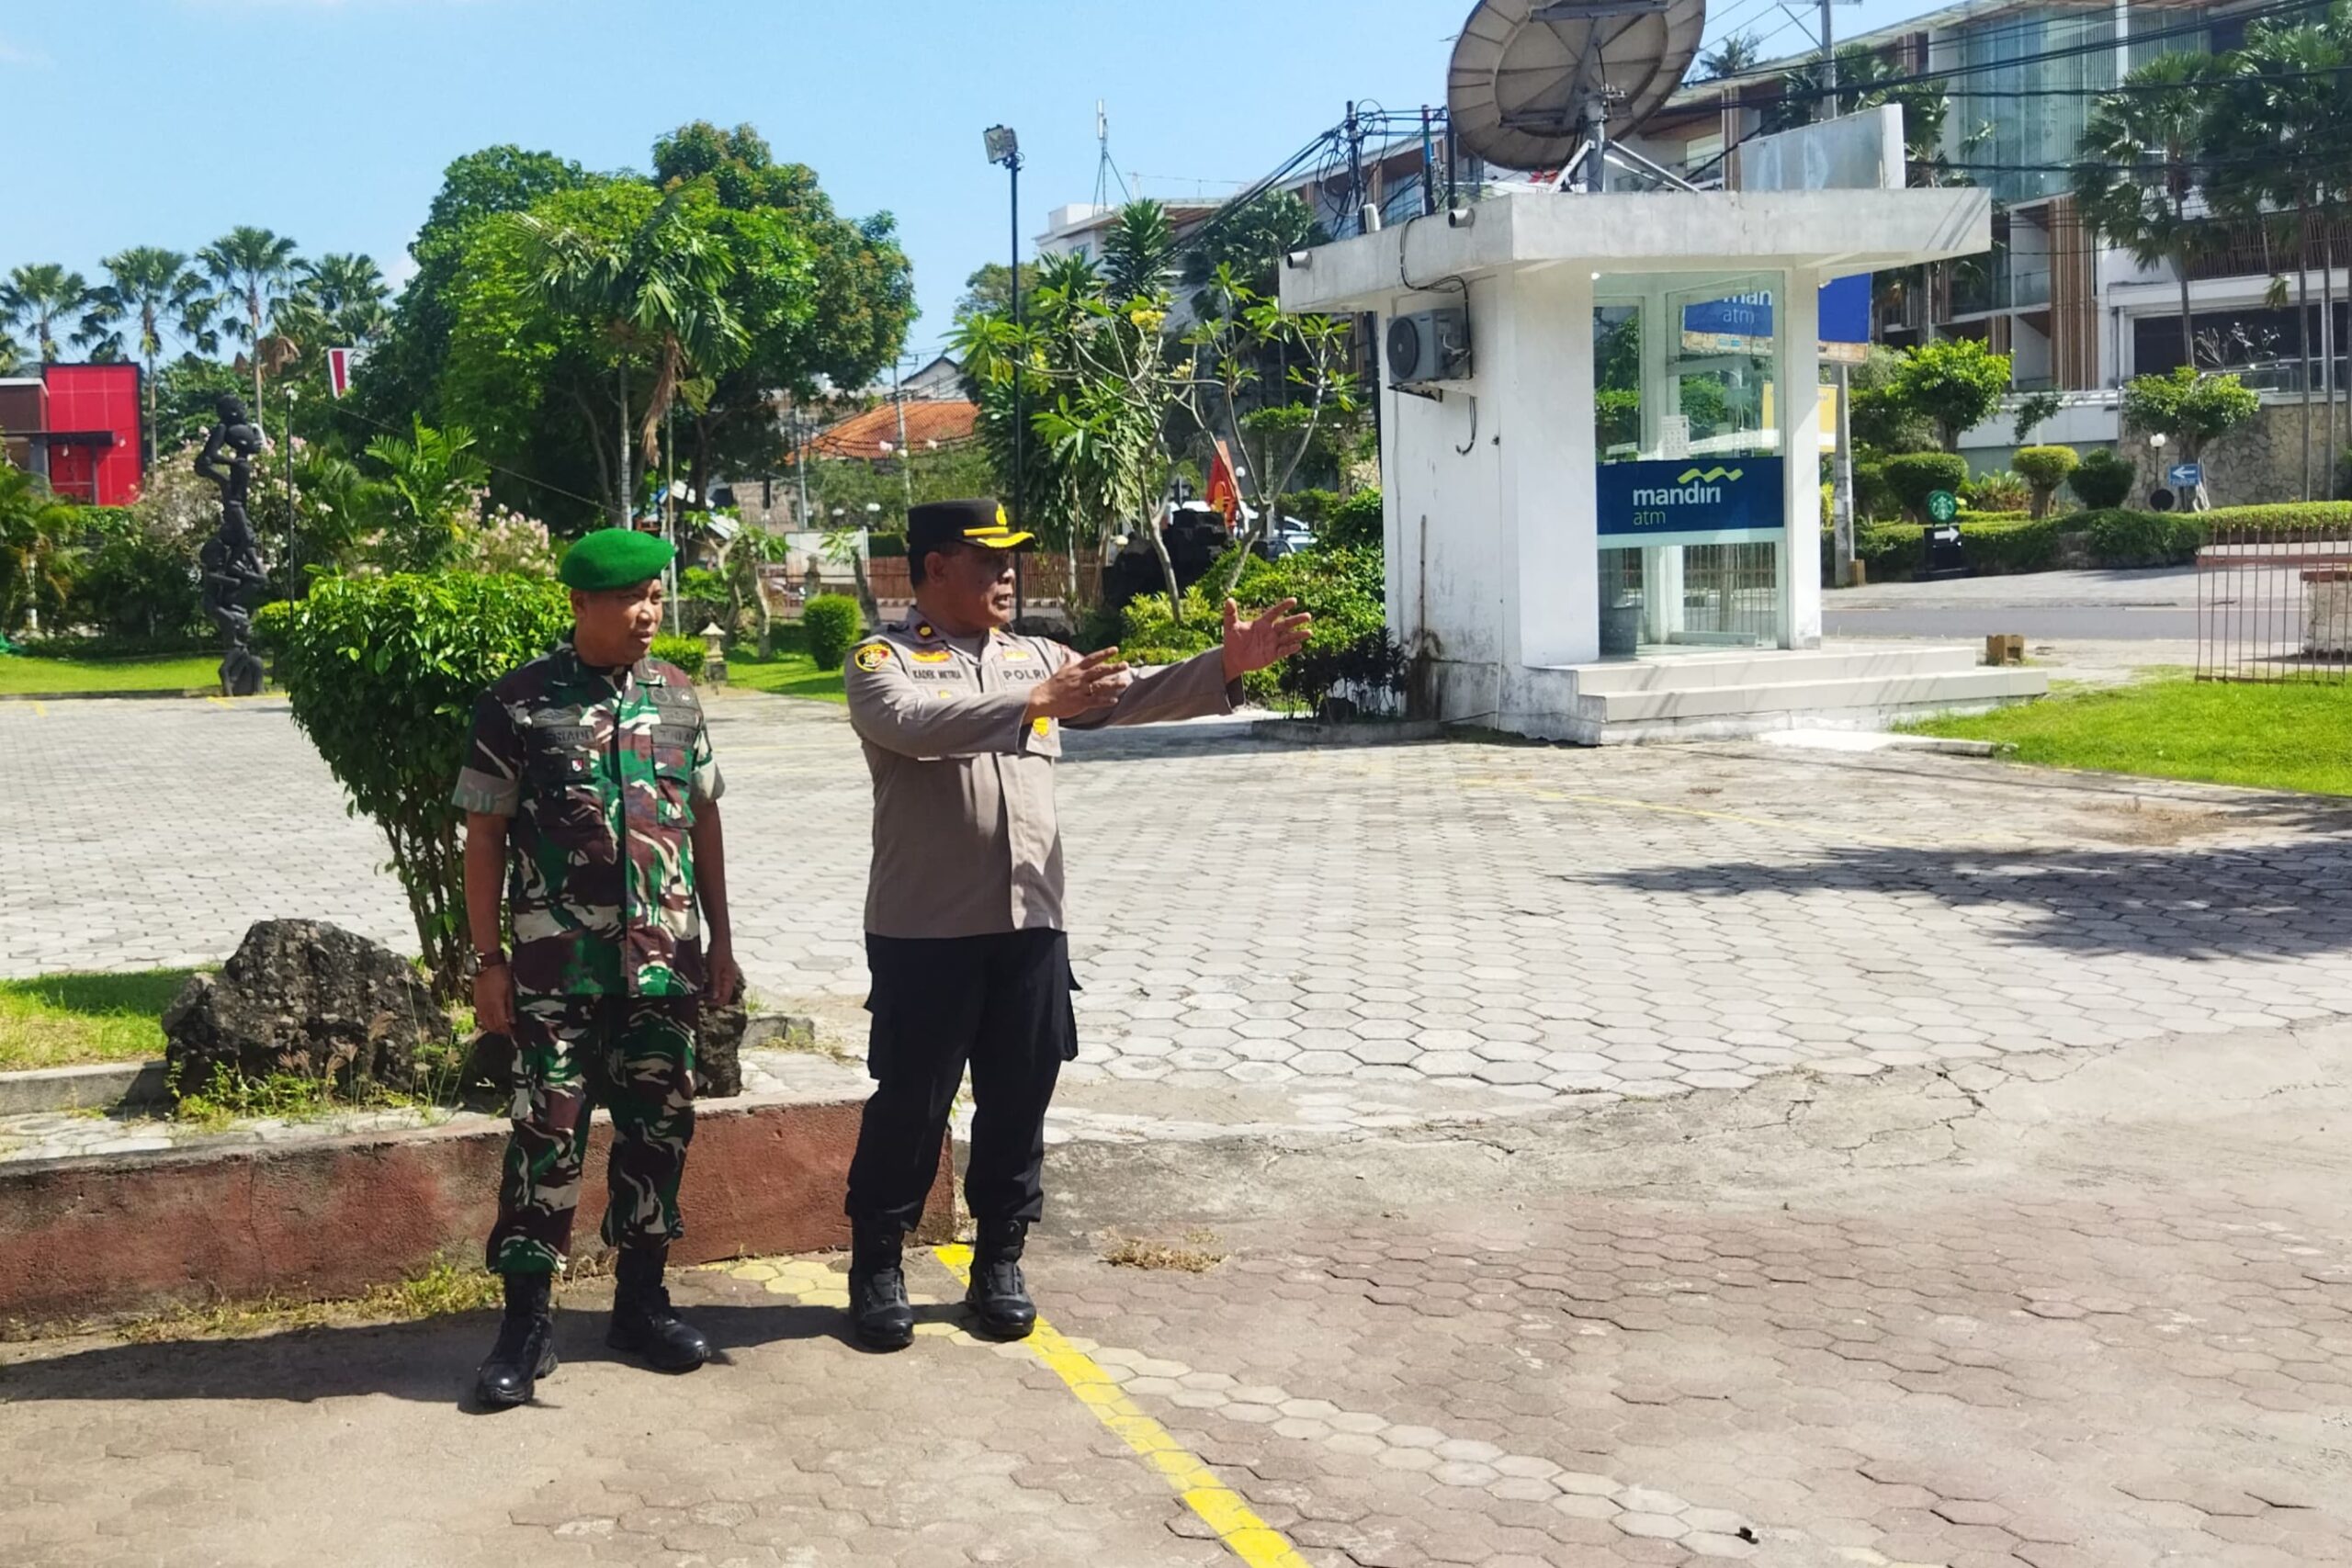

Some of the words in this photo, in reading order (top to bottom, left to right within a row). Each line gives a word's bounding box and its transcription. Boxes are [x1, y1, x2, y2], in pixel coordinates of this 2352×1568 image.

[1723, 308, 1755, 324] atm
[1633, 480, 1721, 506] mandiri
[1633, 511, 1667, 525] atm
[1002, 669, 1047, 681] POLRI
